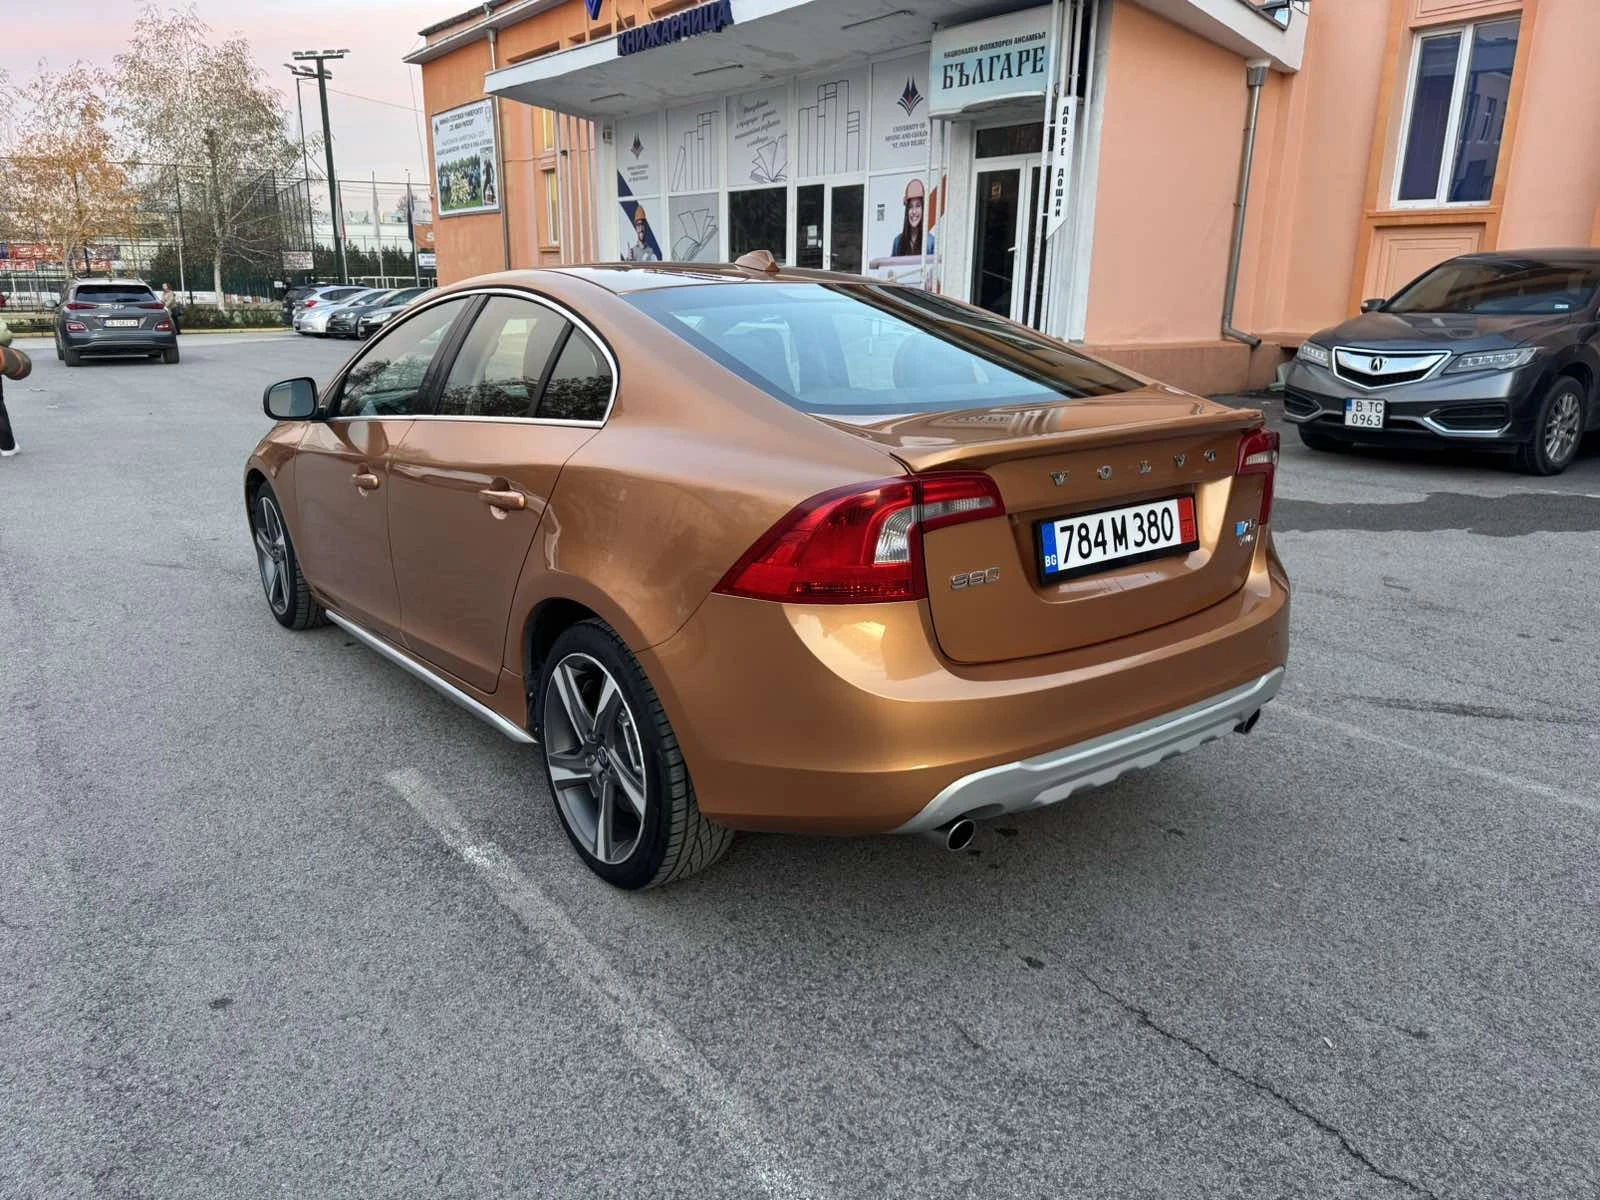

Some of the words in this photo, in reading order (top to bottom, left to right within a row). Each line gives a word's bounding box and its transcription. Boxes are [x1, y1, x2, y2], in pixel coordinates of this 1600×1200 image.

[618, 0, 734, 56] КНИЖАРНИЦА
[1014, 31, 1046, 45] АНСАМБЪЛ
[942, 46, 1045, 90] БЪЛГАРЕ
[1060, 105, 1070, 156] ДОБРЕ
[1055, 168, 1064, 217] ДОШЛИ
[1352, 413, 1381, 426] 0963
[1051, 449, 1217, 487] VOLVO
[1045, 555, 1057, 567] BG
